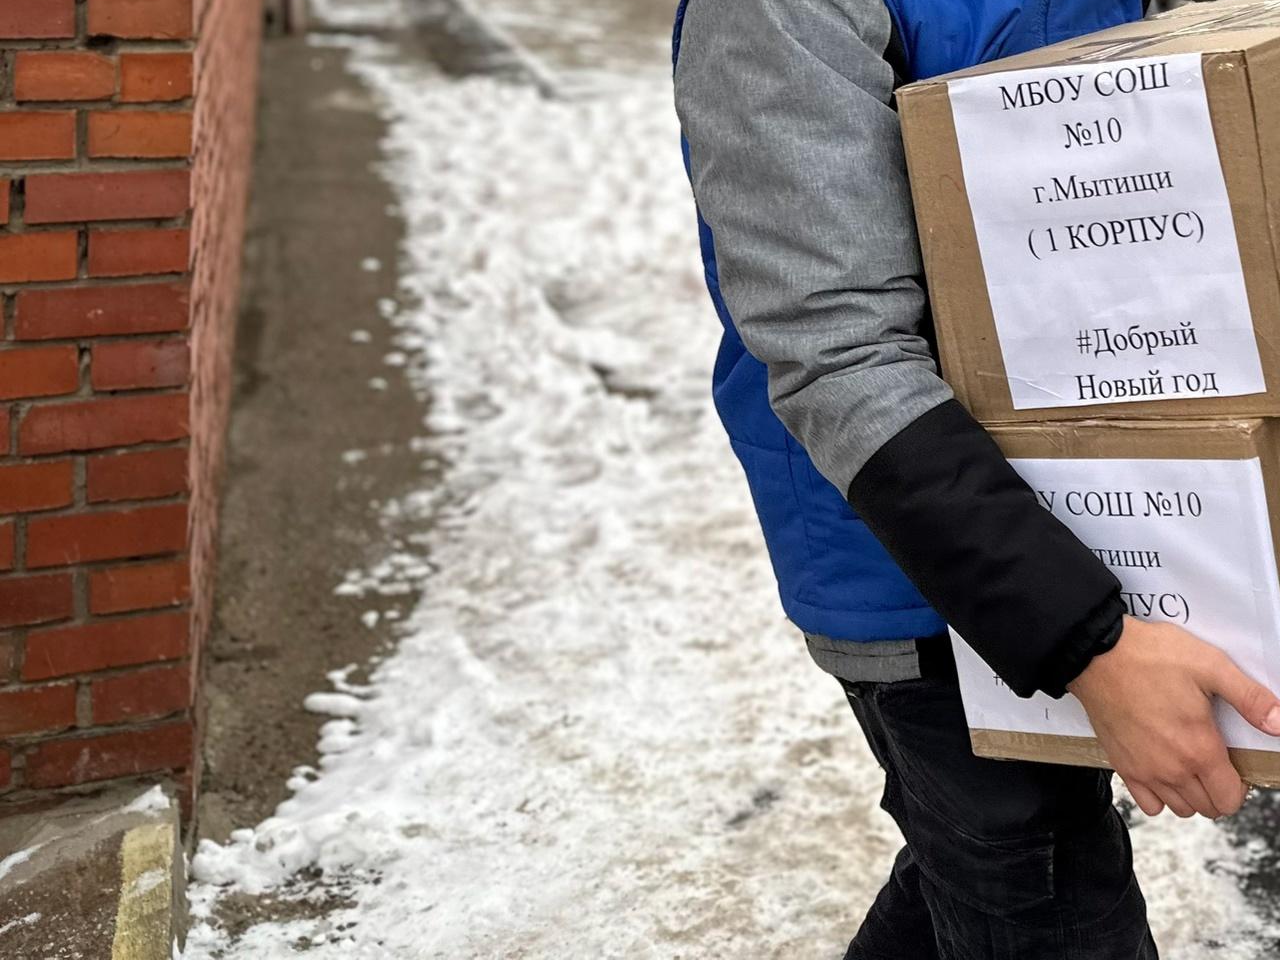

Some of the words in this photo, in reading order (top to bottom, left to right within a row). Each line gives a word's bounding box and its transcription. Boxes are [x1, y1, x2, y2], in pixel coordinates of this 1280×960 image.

[998, 75, 1084, 110] МБОУ
[1094, 62, 1171, 96] СОШ
[1062, 117, 1123, 149] №10
[1032, 170, 1175, 205] г.Мытищи
[1064, 210, 1205, 250] КОРПУС)
[1075, 321, 1199, 359] #Добрый
[1074, 369, 1165, 400] Новый
[1171, 372, 1220, 394] год
[1065, 490, 1135, 518] СОШ
[1143, 491, 1203, 518] №10
[1091, 548, 1162, 571] тищи
